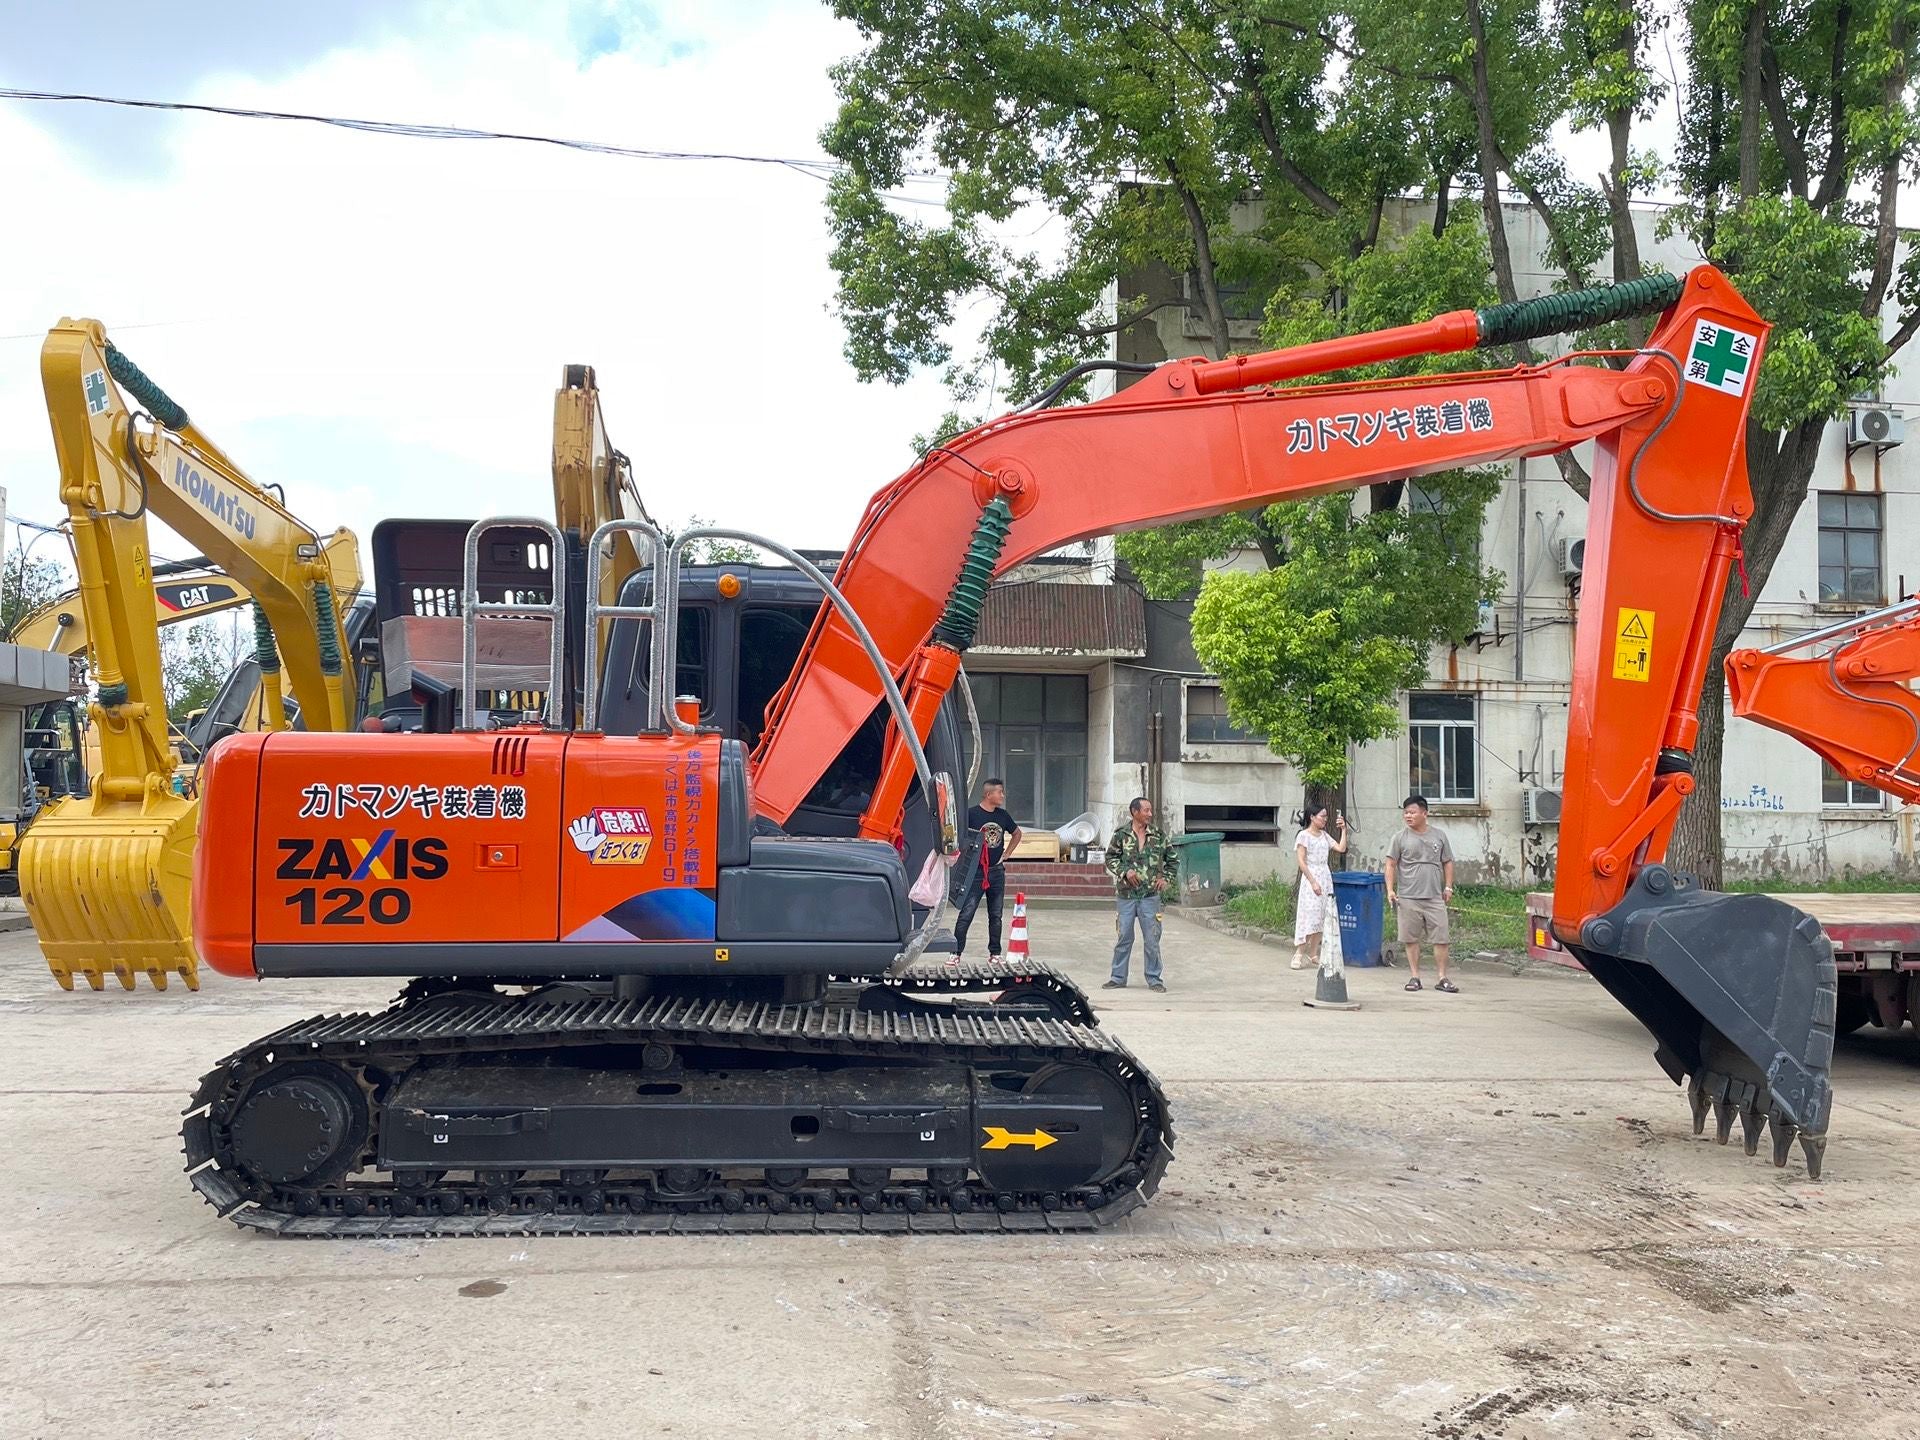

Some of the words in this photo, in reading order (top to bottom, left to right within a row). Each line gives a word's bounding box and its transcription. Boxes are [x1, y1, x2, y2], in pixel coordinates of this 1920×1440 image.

[175, 457, 256, 540] KOMATSU
[179, 586, 210, 608] CAT
[277, 829, 449, 880] ZAXIS
[285, 888, 411, 925] 120
